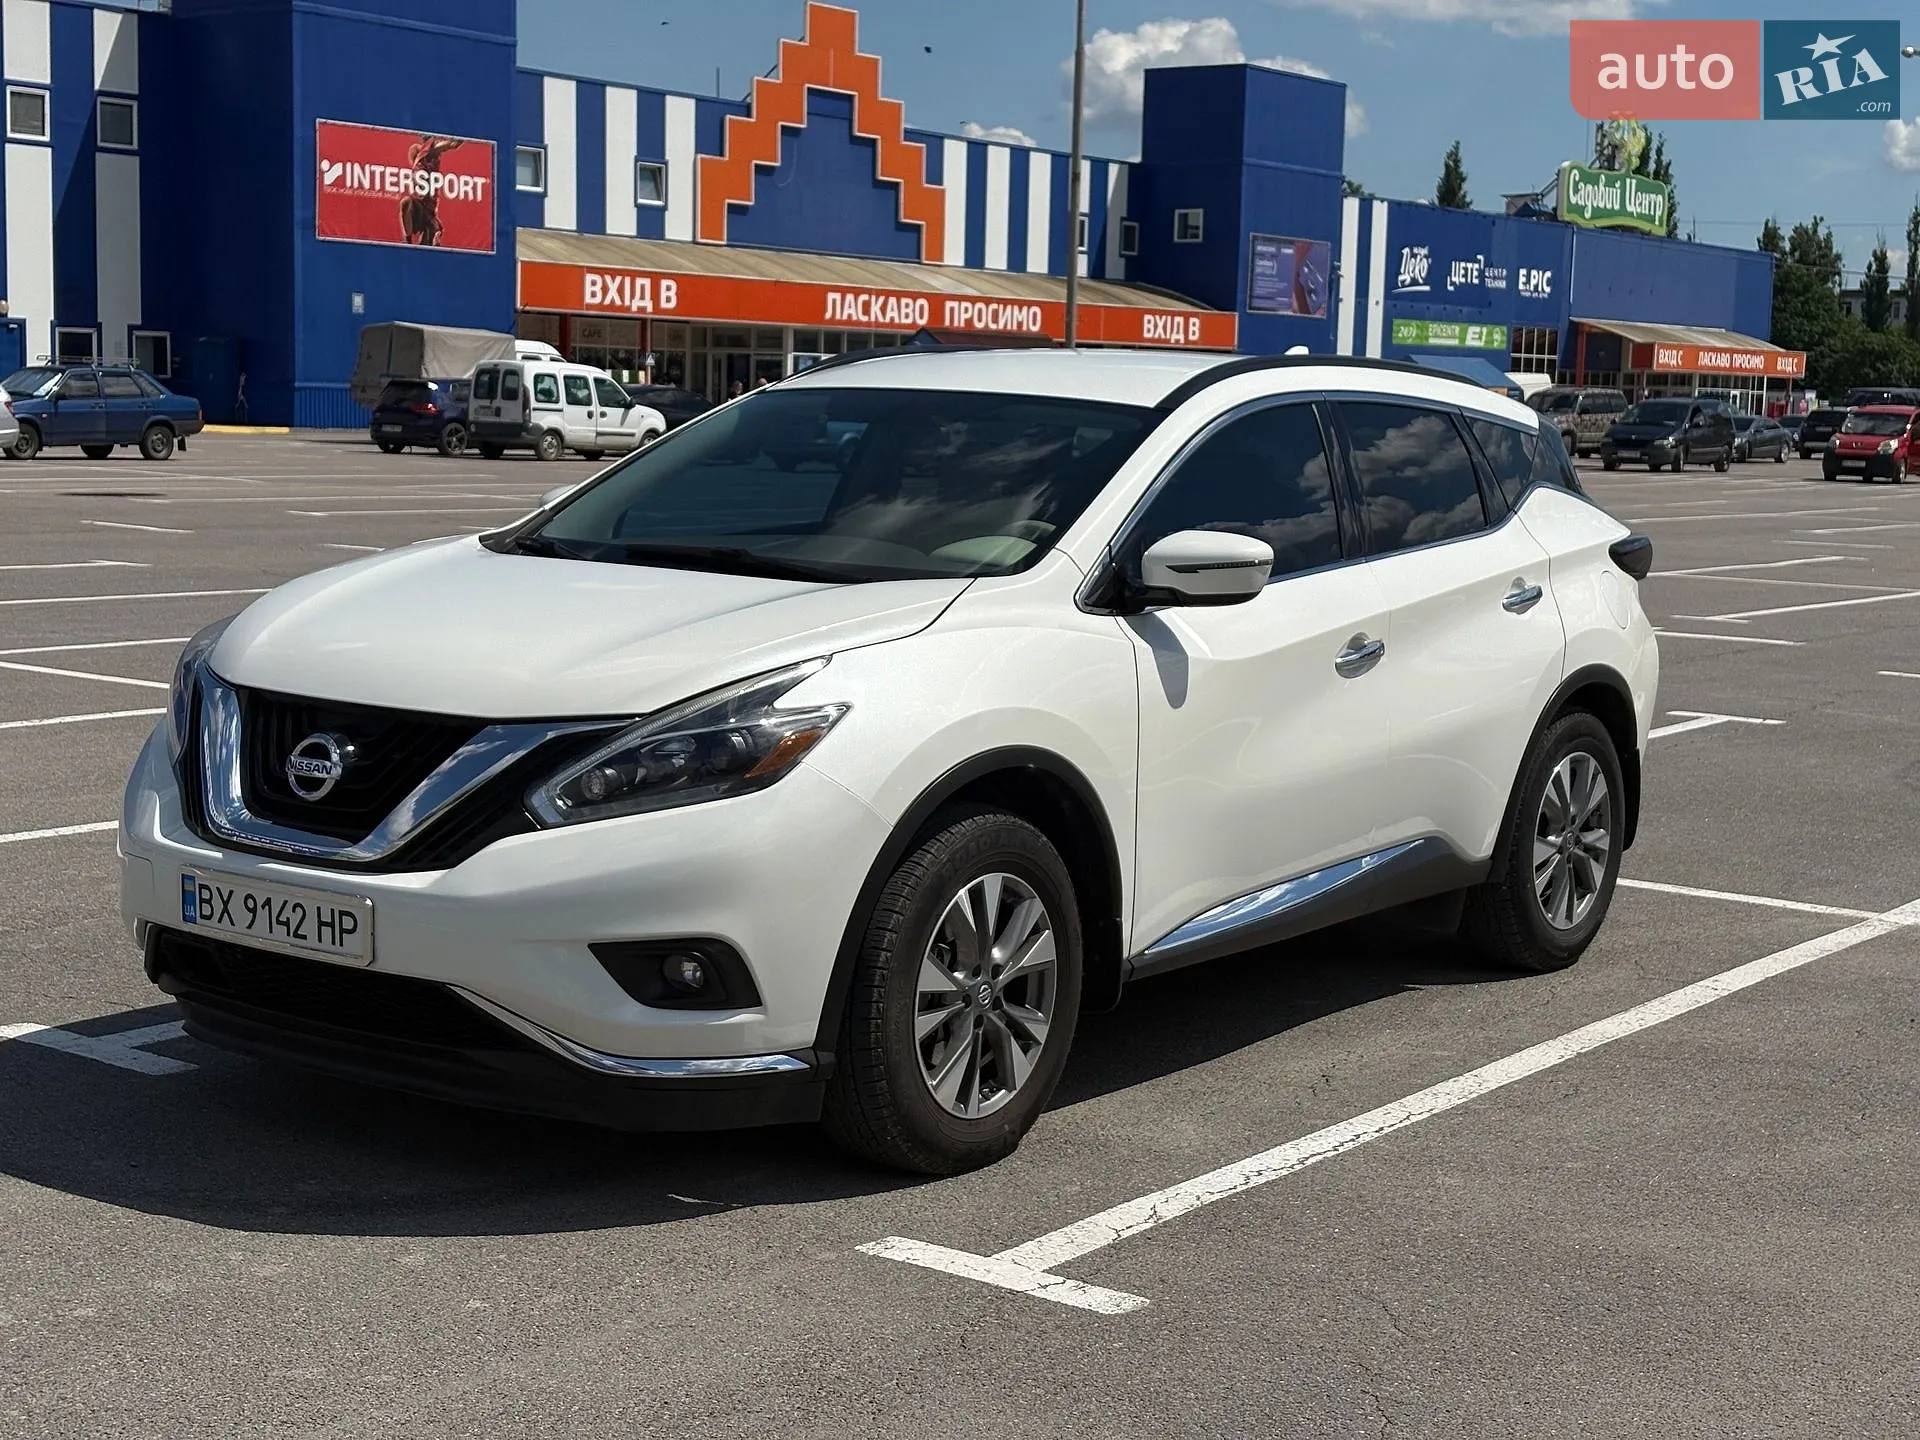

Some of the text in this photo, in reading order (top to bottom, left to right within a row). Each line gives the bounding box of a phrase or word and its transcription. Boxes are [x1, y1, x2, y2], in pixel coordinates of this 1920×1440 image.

[345, 161, 487, 202] INTERSPORT
[1569, 168, 1663, 225] Садовий Центр
[584, 273, 678, 312] ВХІД В
[825, 292, 1042, 333] ЛАСКАВО ПРОСИМО
[1143, 314, 1200, 345] ВХІД В
[1658, 349, 1677, 367] ВХІД
[1698, 351, 1765, 370] ЛАСКАВО ПРОСИМО
[1776, 356, 1793, 374] ВХІД
[289, 756, 333, 776] NISSAN
[184, 883, 358, 948] UA BX 9142 HP
